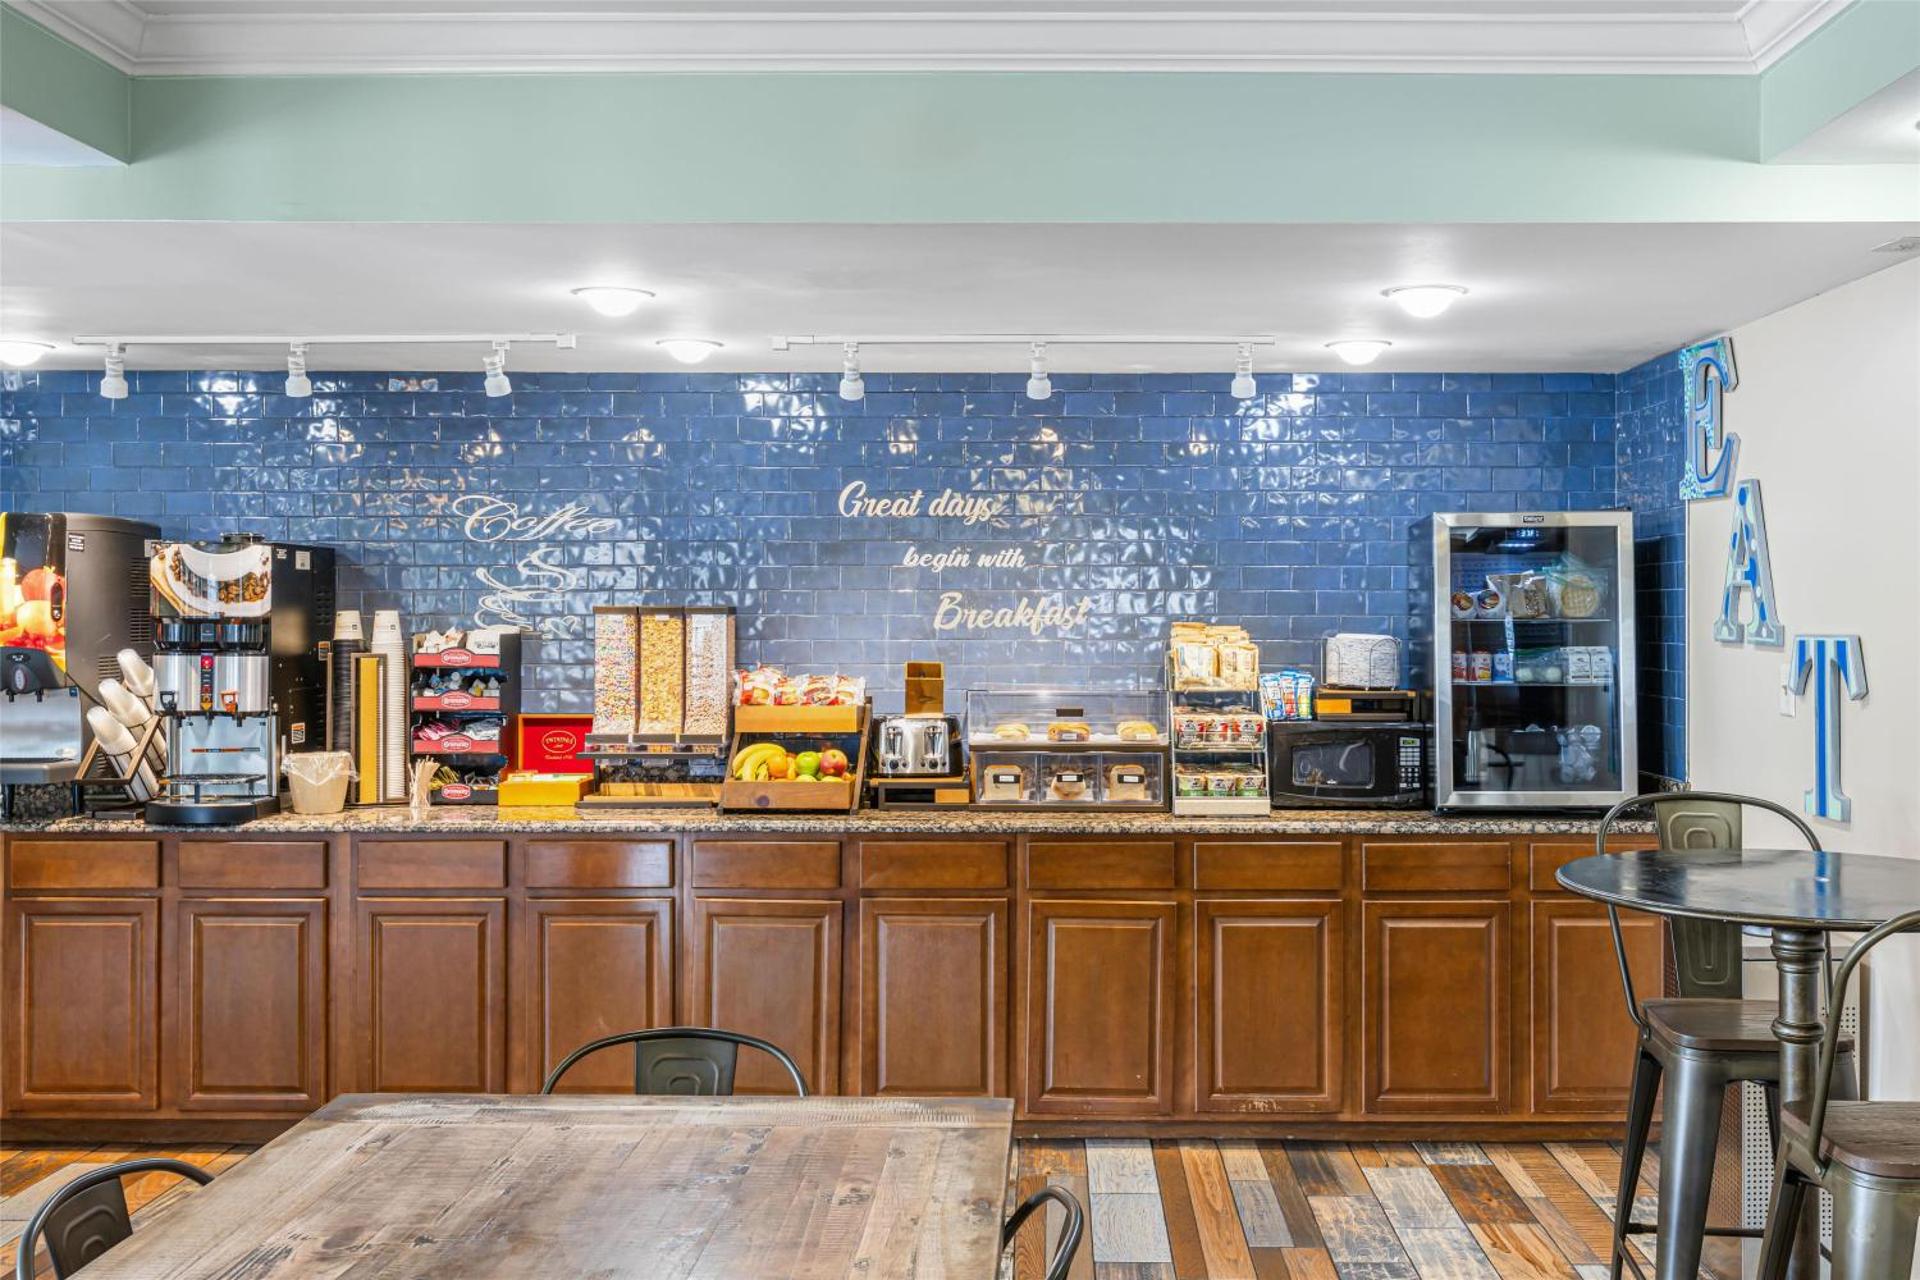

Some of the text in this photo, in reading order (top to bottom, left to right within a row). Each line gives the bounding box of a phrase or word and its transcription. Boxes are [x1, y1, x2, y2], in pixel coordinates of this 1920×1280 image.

[452, 495, 616, 542] Coffee
[838, 480, 994, 525] Great days
[903, 546, 1026, 573] begin with
[933, 591, 1091, 636] Breakfast
